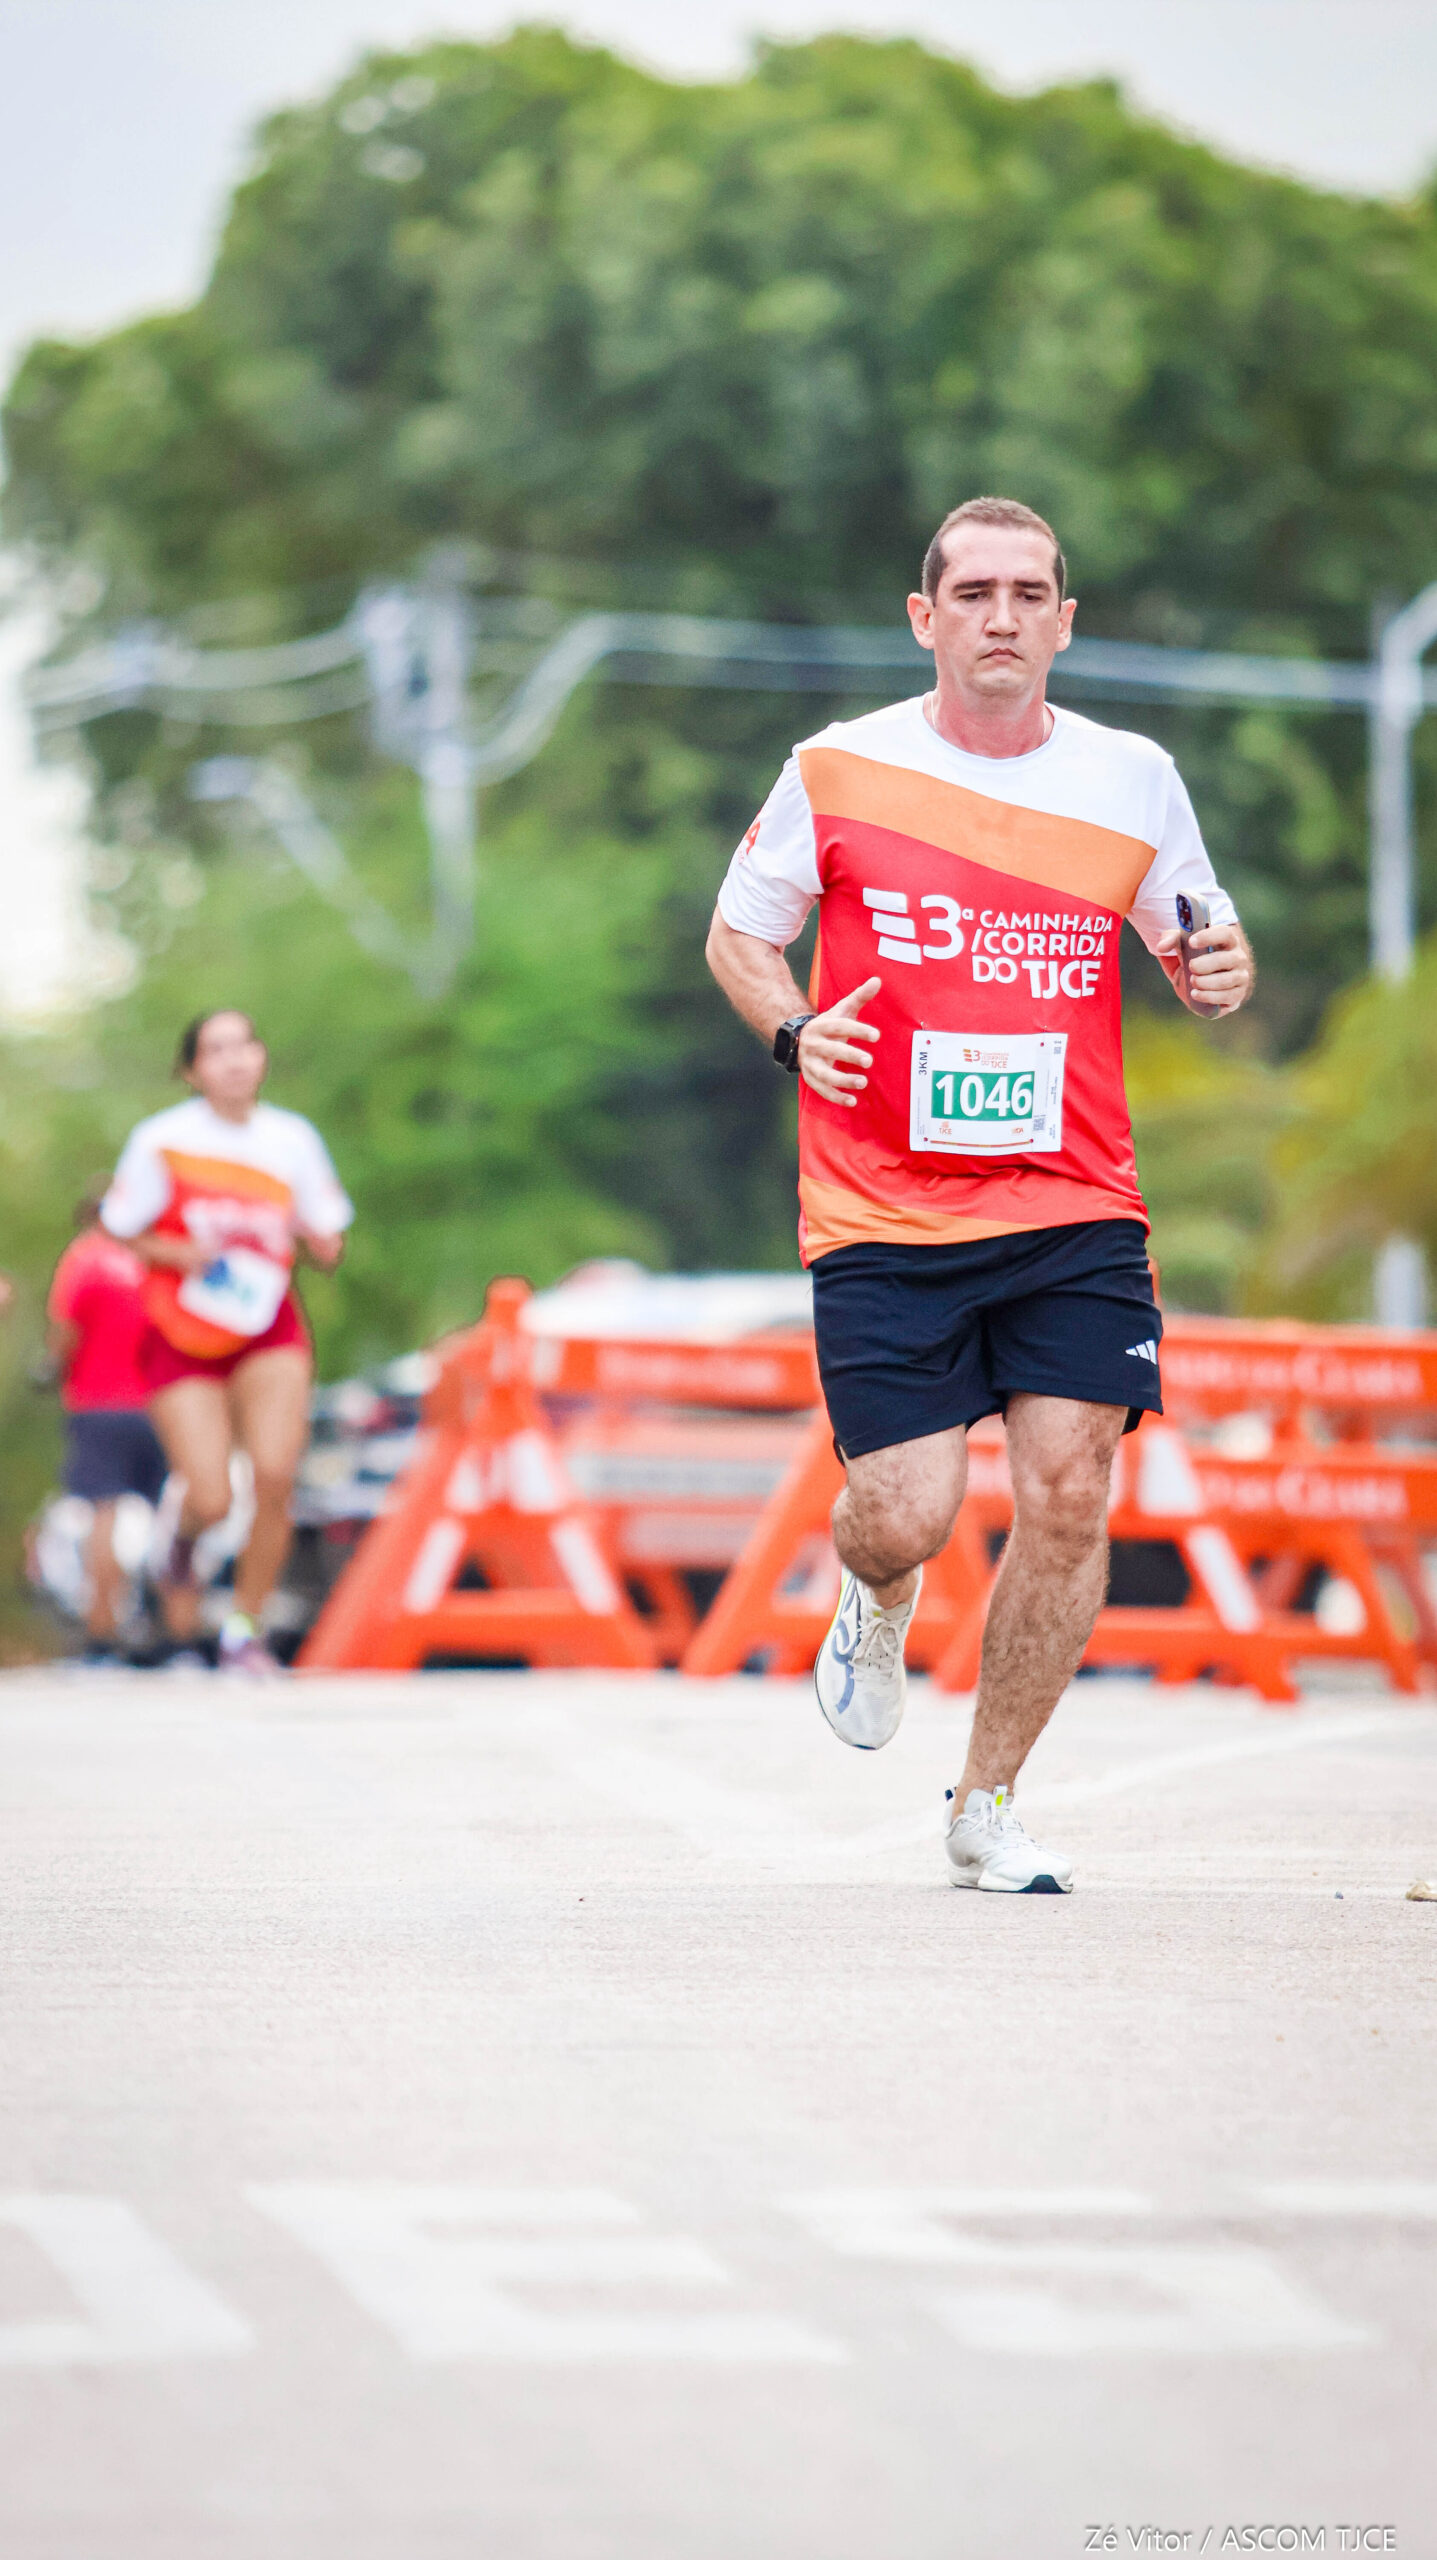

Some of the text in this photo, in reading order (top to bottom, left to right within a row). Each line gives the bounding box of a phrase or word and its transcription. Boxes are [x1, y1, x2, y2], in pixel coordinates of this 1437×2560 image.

[980, 910, 1113, 933] CAMINHADA
[971, 928, 1105, 957] /CORRIDA
[972, 955, 1101, 999] DO TJCE
[918, 1051, 928, 1075] 3KM
[935, 1074, 1033, 1117] 1046
